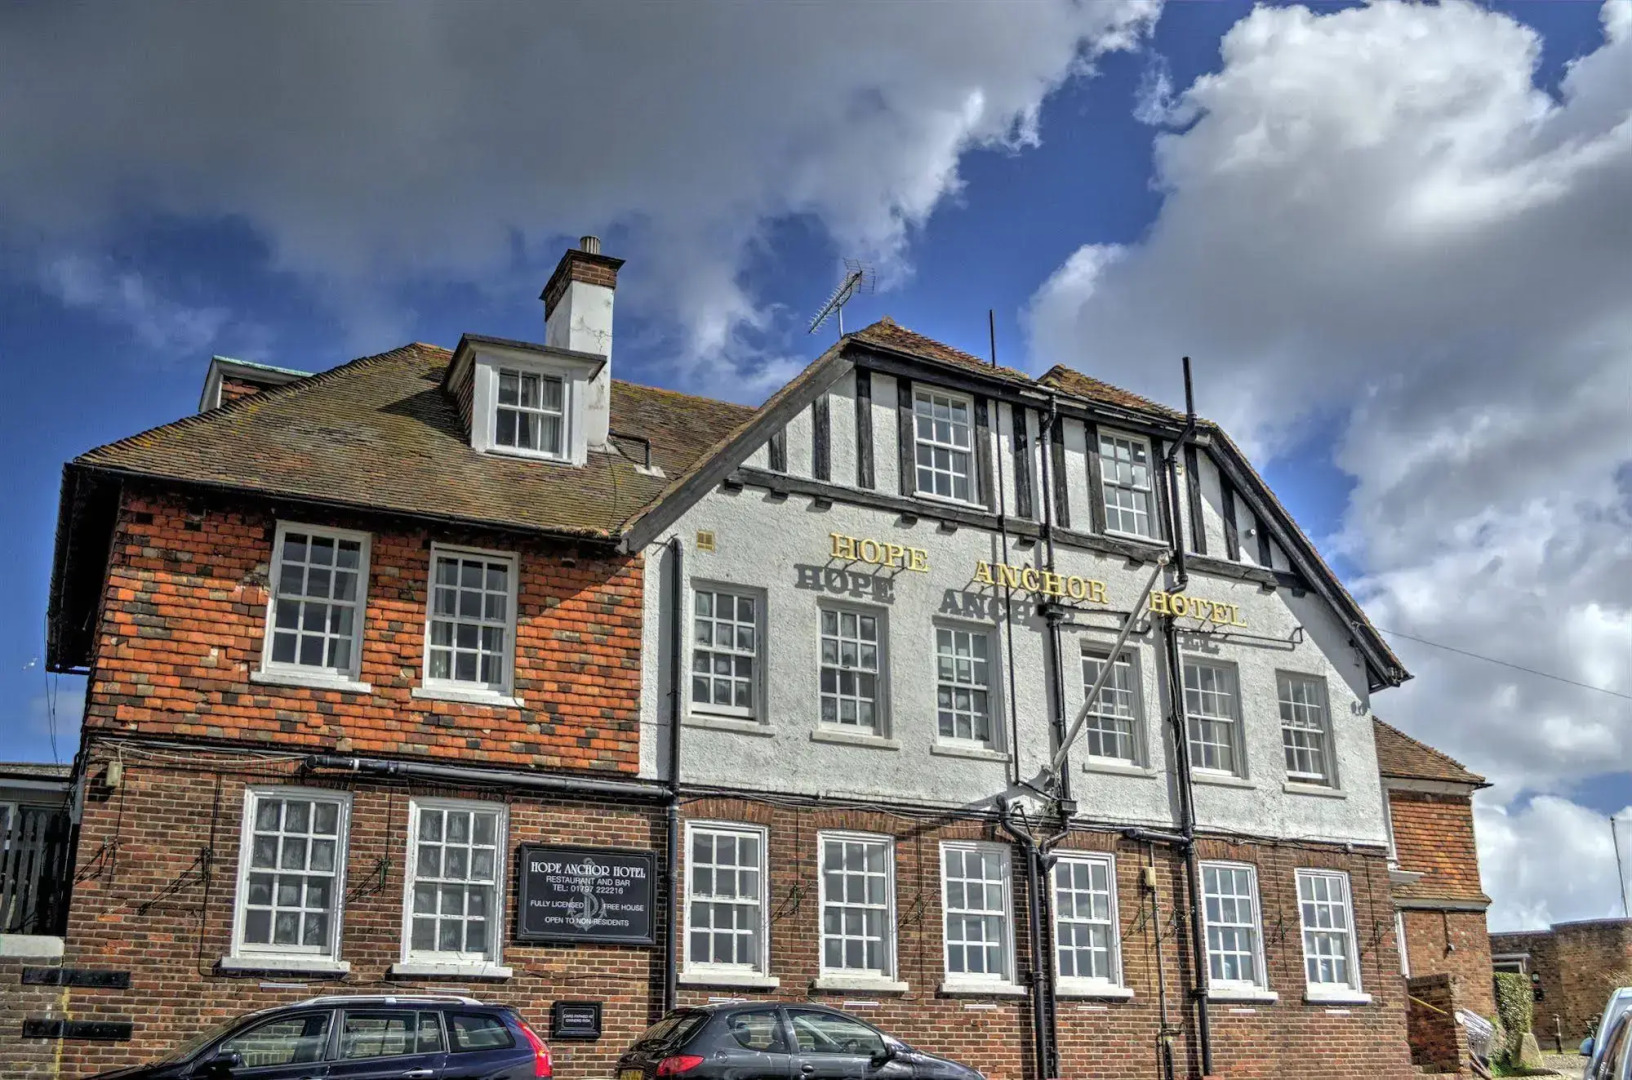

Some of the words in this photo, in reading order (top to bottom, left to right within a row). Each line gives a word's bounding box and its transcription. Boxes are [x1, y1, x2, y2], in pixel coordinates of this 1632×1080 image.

[829, 532, 929, 573] HOPE
[972, 560, 1109, 604] ANCHOR
[1149, 590, 1248, 627] HOTEL
[531, 861, 562, 873] HOPE
[564, 863, 610, 877] ANCHOR
[613, 866, 646, 878] HOTEL
[546, 875, 595, 885] RESTAURANT
[615, 879, 631, 887] BAR
[553, 884, 569, 892] TEL:
[570, 885, 593, 893] 01797
[530, 899, 550, 907] FULLY
[551, 900, 584, 909] LICENSED
[603, 903, 620, 911] FREE
[621, 904, 644, 912] HOUSE
[544, 916, 564, 924] OPEN
[565, 916, 575, 924] TO
